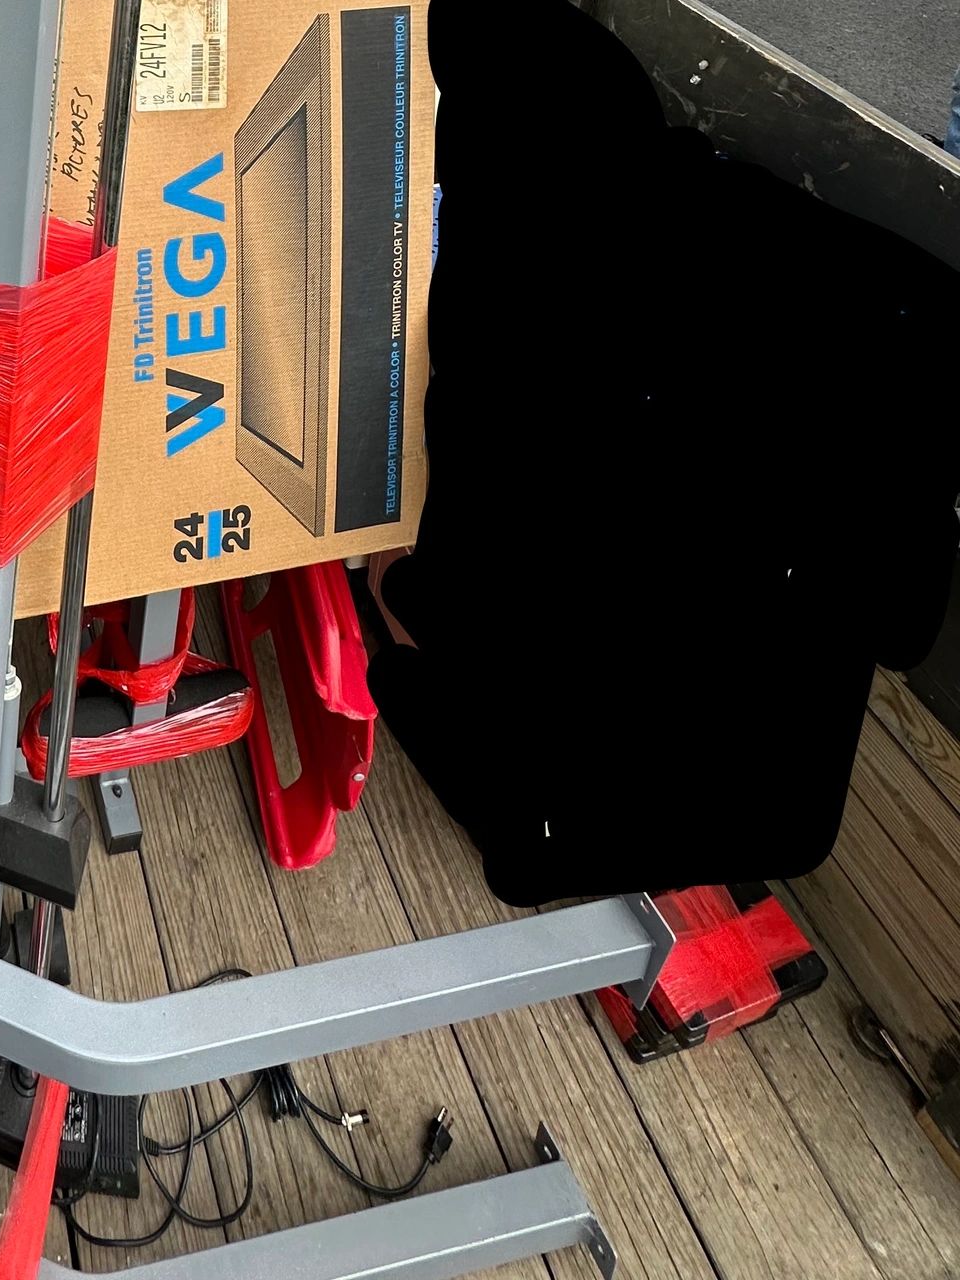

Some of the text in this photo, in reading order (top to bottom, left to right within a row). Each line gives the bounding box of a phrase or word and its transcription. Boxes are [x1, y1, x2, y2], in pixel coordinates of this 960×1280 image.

[139, 23, 167, 79] 24FV12
[166, 85, 174, 103] 120V
[179, 92, 191, 103] S
[60, 86, 93, 182] PICTURES
[386, 15, 406, 515] TELEVISOR TRINITRON A COLOR TRINITRON COLOR TV TELEVISEUR COULEUR TRINITRON
[133, 248, 155, 383] FD Trinitron
[162, 151, 228, 458] WEGA
[173, 512, 205, 563] 24
[221, 504, 252, 554] 25
